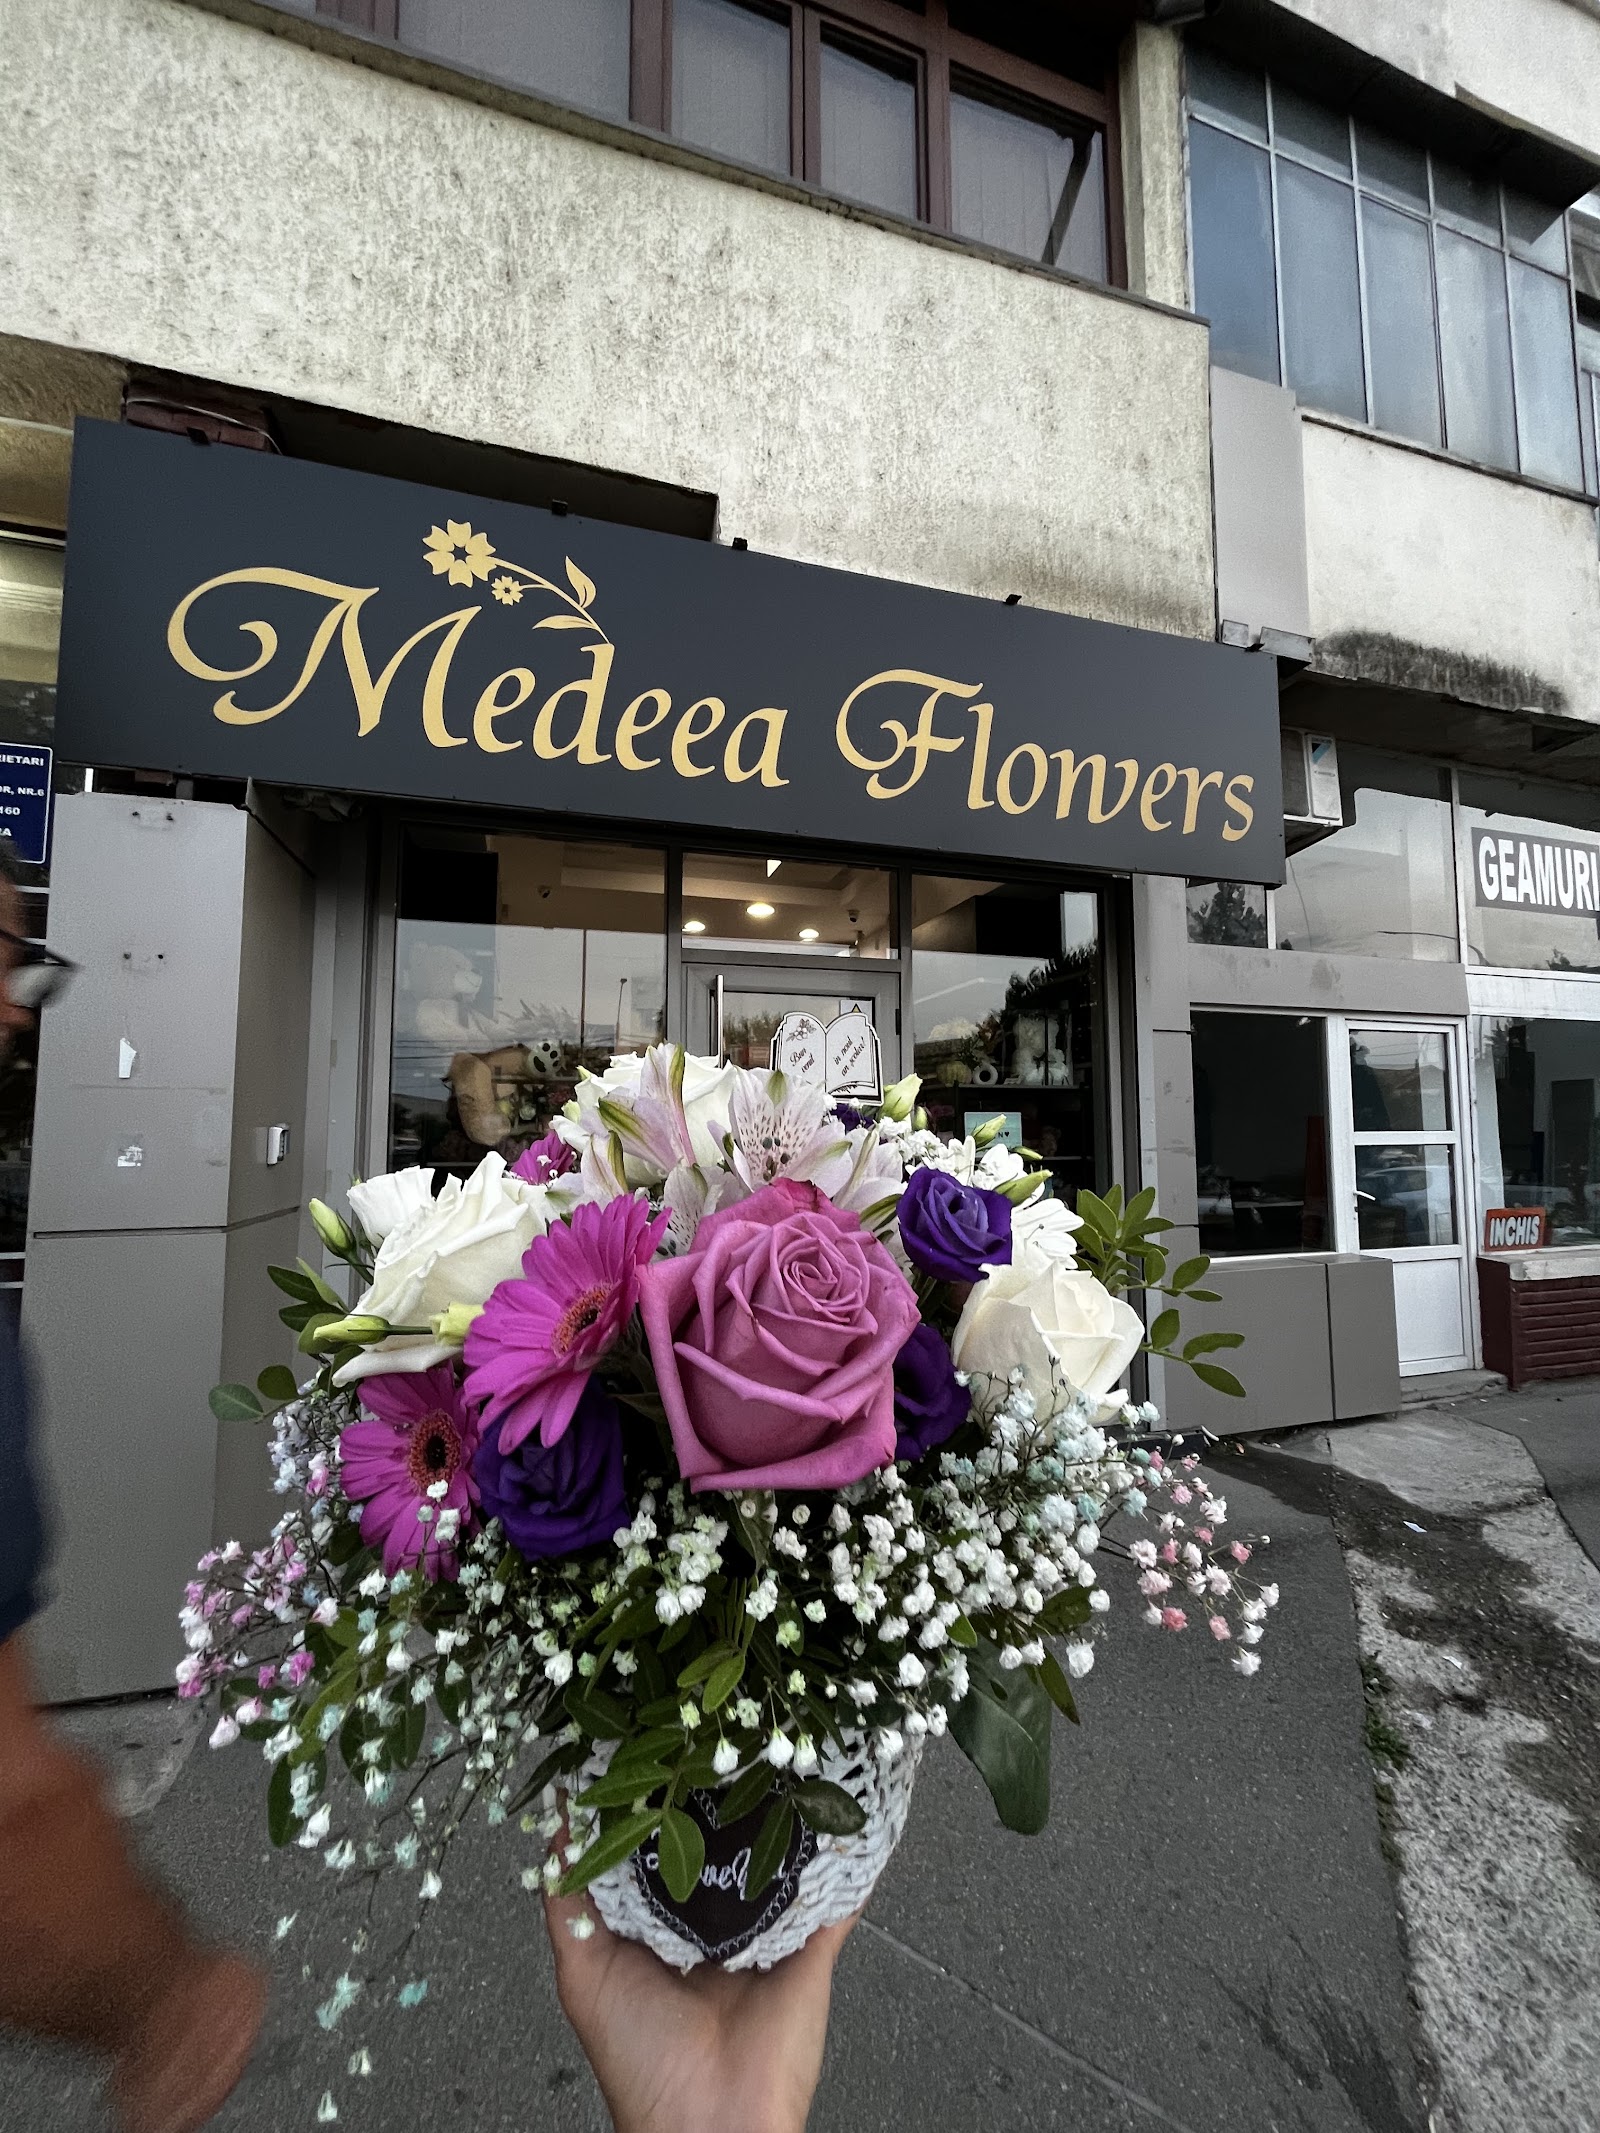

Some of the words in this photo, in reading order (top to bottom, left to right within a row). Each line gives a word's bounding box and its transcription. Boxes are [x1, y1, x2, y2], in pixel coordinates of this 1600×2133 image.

[168, 567, 788, 787] Medeea
[836, 669, 1254, 842] Flowers
[1479, 836, 1600, 911] GEAMURI
[790, 1048, 807, 1067] Bun
[1490, 1216, 1540, 1247] INCHIS
